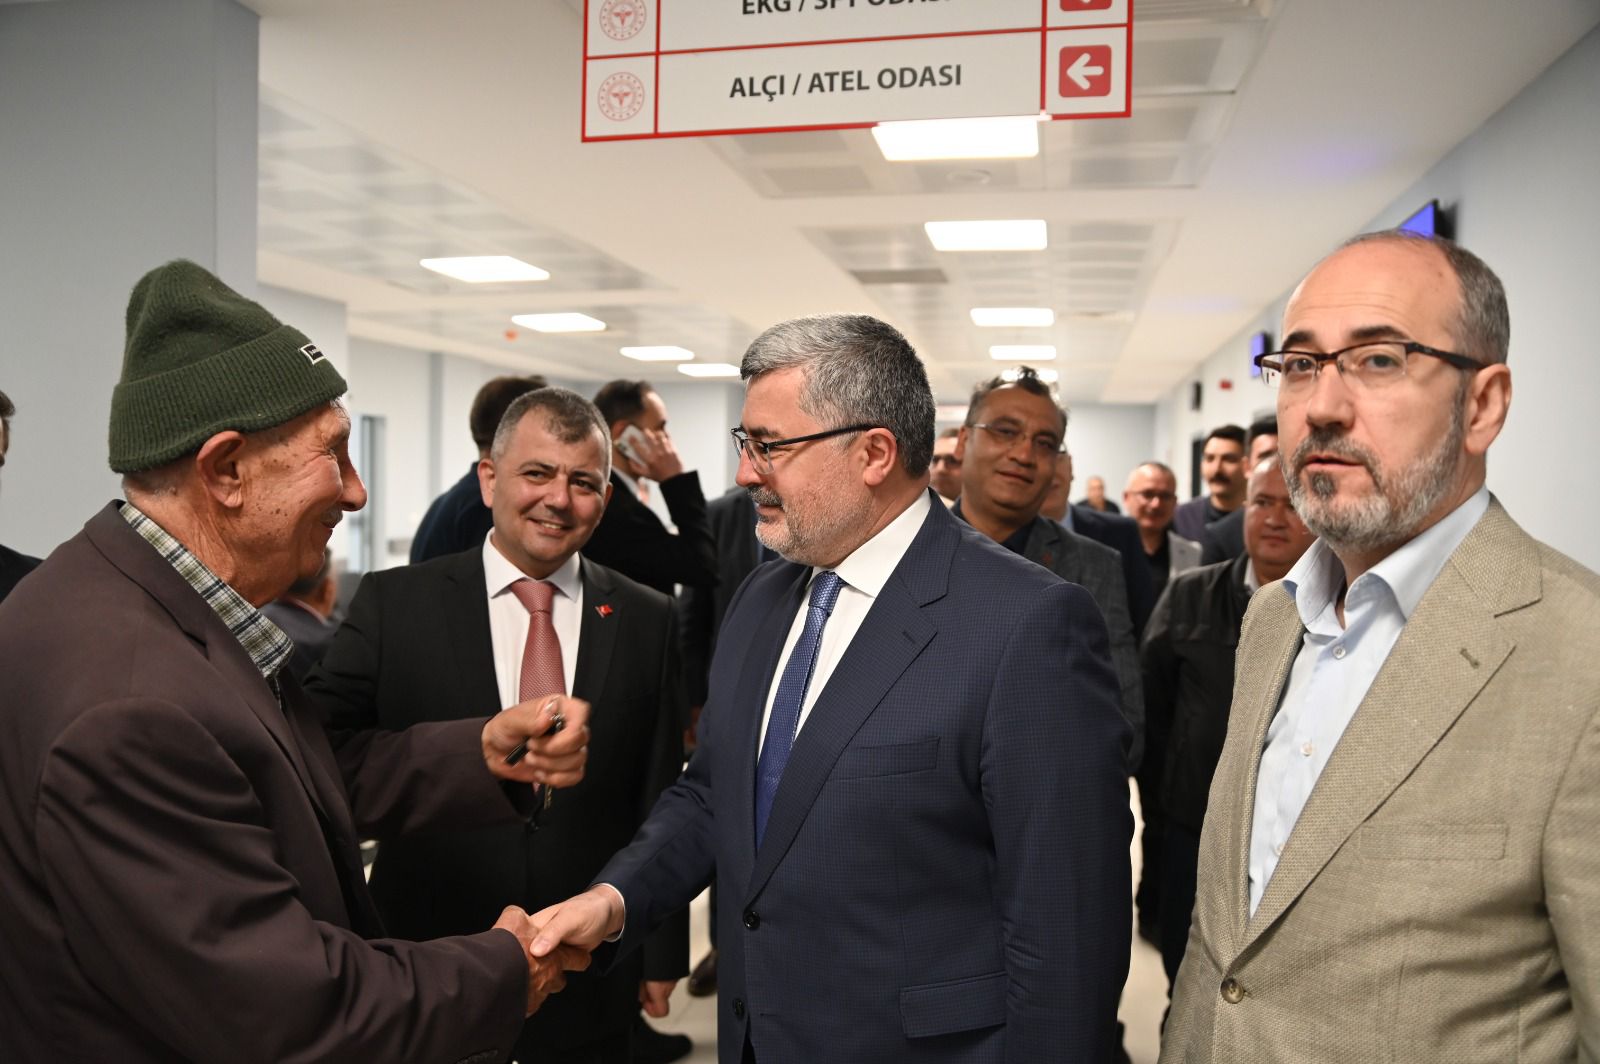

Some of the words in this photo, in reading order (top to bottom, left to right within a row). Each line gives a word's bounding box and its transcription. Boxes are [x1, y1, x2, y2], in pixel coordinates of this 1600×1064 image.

[741, 0, 792, 15] EKG
[729, 74, 785, 102] ALÇI
[792, 73, 802, 96] /
[807, 70, 870, 94] ATEL
[876, 64, 962, 90] ODASI
